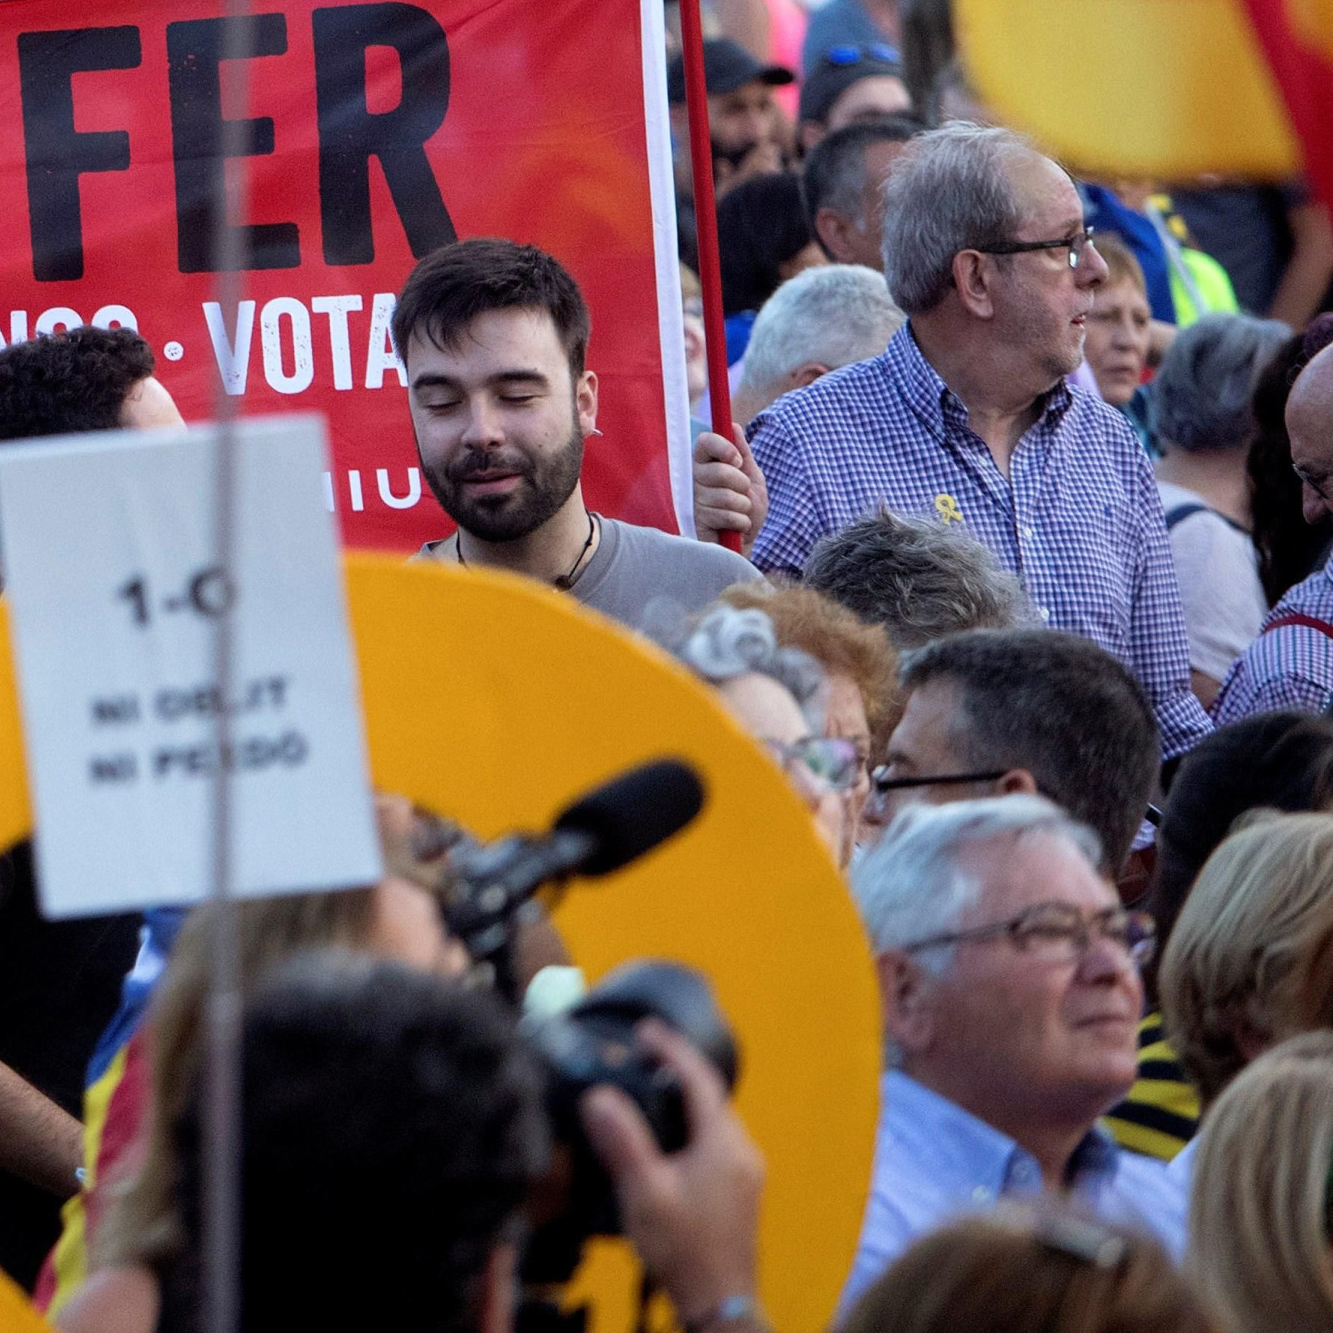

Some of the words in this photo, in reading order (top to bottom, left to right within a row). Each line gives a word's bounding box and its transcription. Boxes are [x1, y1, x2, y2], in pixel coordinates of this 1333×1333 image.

[16, 1, 459, 283] FER
[201, 292, 411, 396] VOTA
[90, 695, 139, 726] NI
[89, 753, 138, 784] NI
